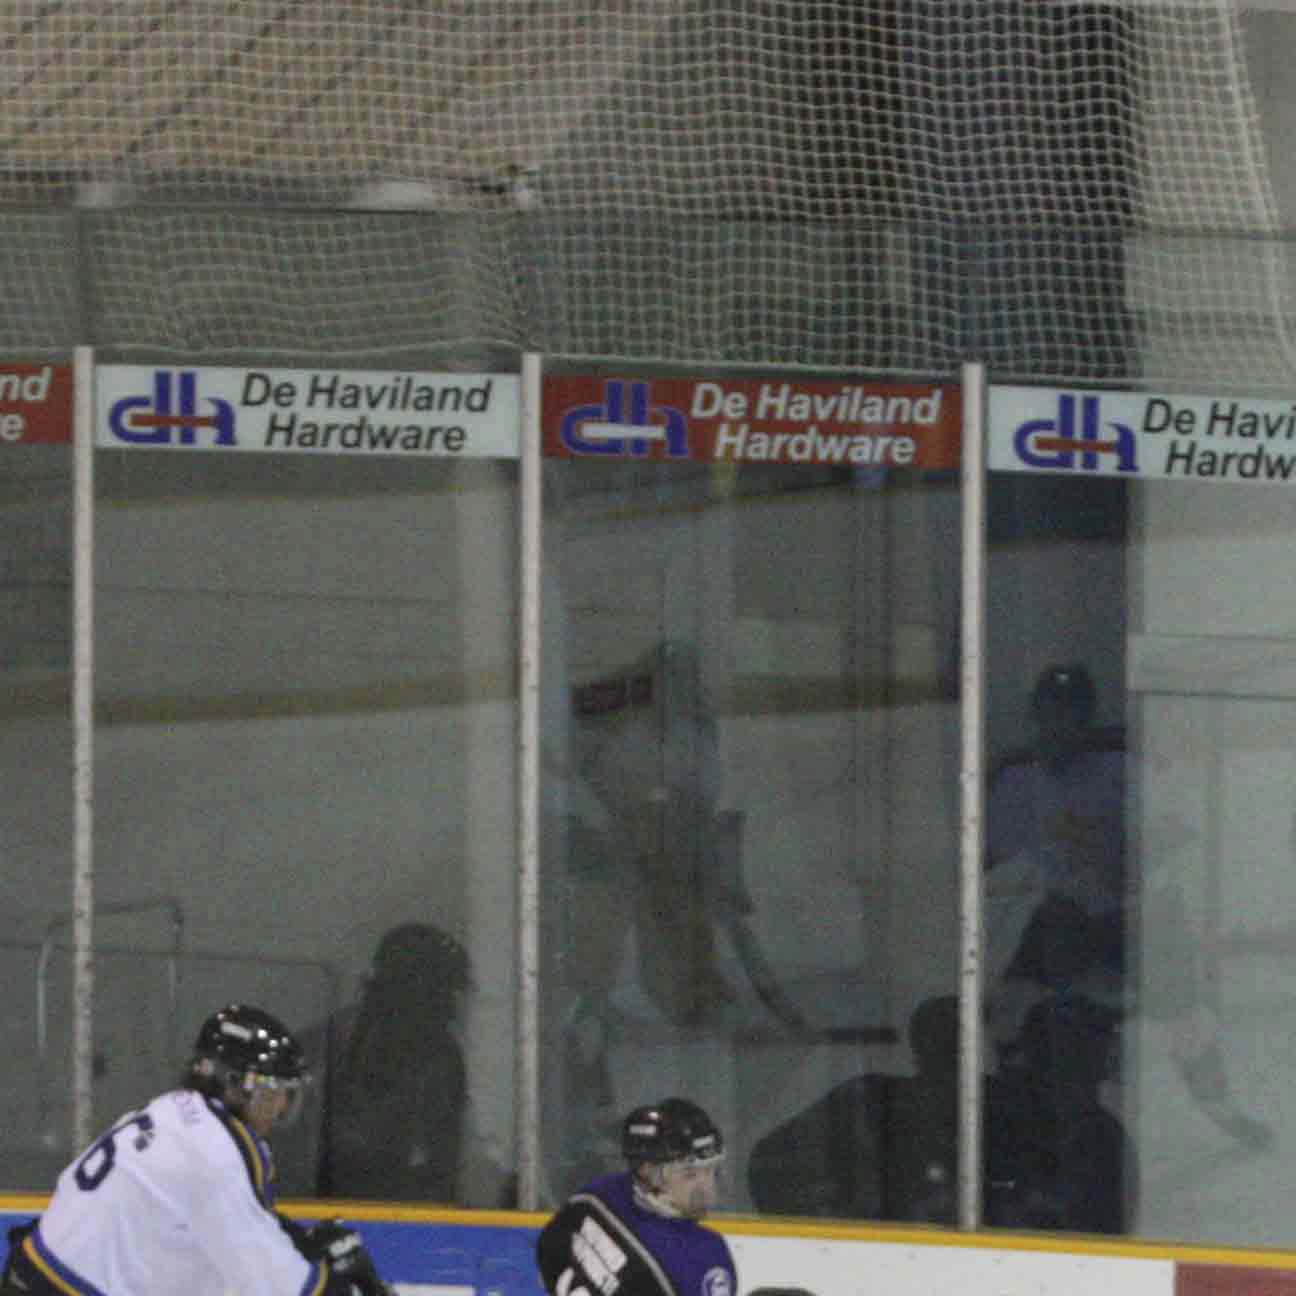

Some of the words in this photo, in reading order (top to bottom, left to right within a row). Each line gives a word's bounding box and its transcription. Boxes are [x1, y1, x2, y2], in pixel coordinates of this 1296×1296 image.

[241, 372, 296, 408] De
[306, 374, 493, 412] Haviland
[691, 382, 747, 419] De
[756, 383, 944, 424] Haviland
[264, 413, 467, 451] Hardware
[1143, 398, 1196, 433] De
[715, 423, 916, 463] Hardware
